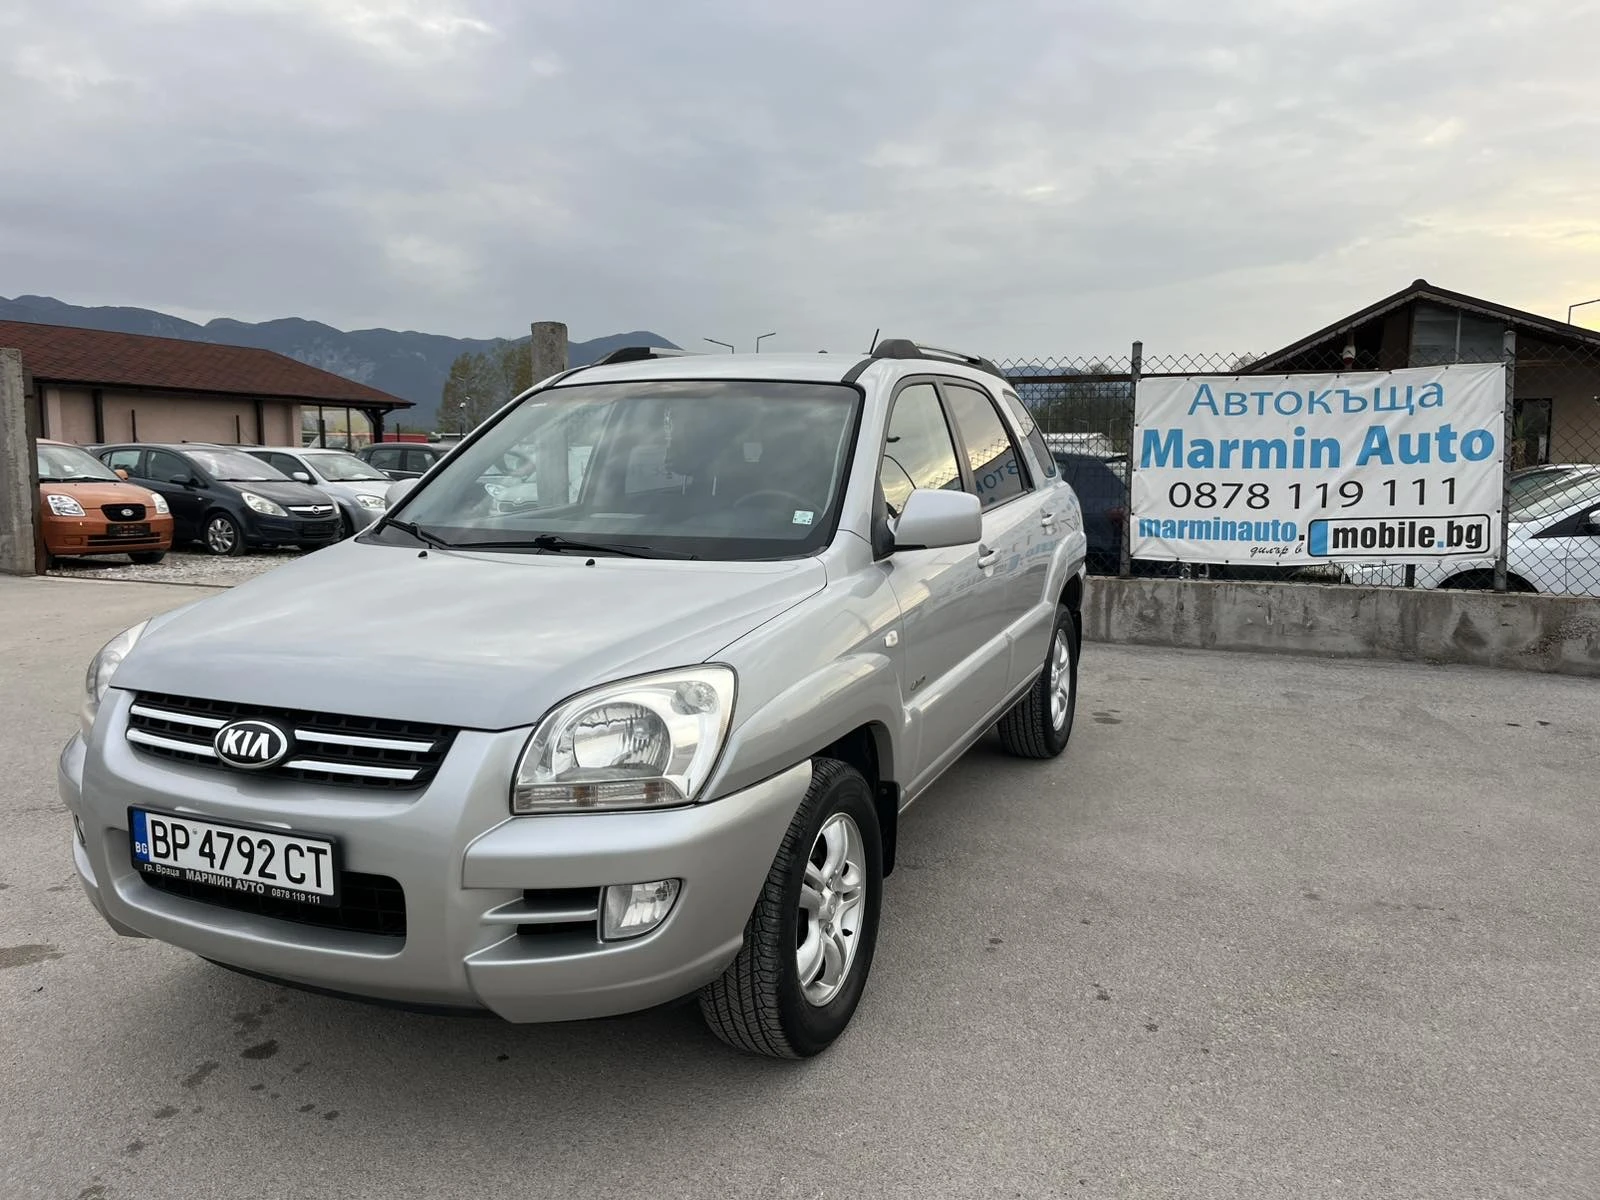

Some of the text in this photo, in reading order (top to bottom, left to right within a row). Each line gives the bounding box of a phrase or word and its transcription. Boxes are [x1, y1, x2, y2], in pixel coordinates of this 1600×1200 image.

[1187, 382, 1444, 417] Автокъща
[1139, 424, 1496, 470] Marmin Auto
[1168, 477, 1456, 510] 0878 119 111
[1332, 520, 1483, 550] mobile.bg
[222, 728, 270, 760] KIA
[135, 842, 148, 855] BG
[198, 829, 277, 880] 4792
[156, 864, 180, 878] Враца
[185, 869, 233, 889] МАРМИН
[235, 878, 265, 895] АУТО
[292, 891, 306, 902] 119
[307, 894, 321, 904] 111
